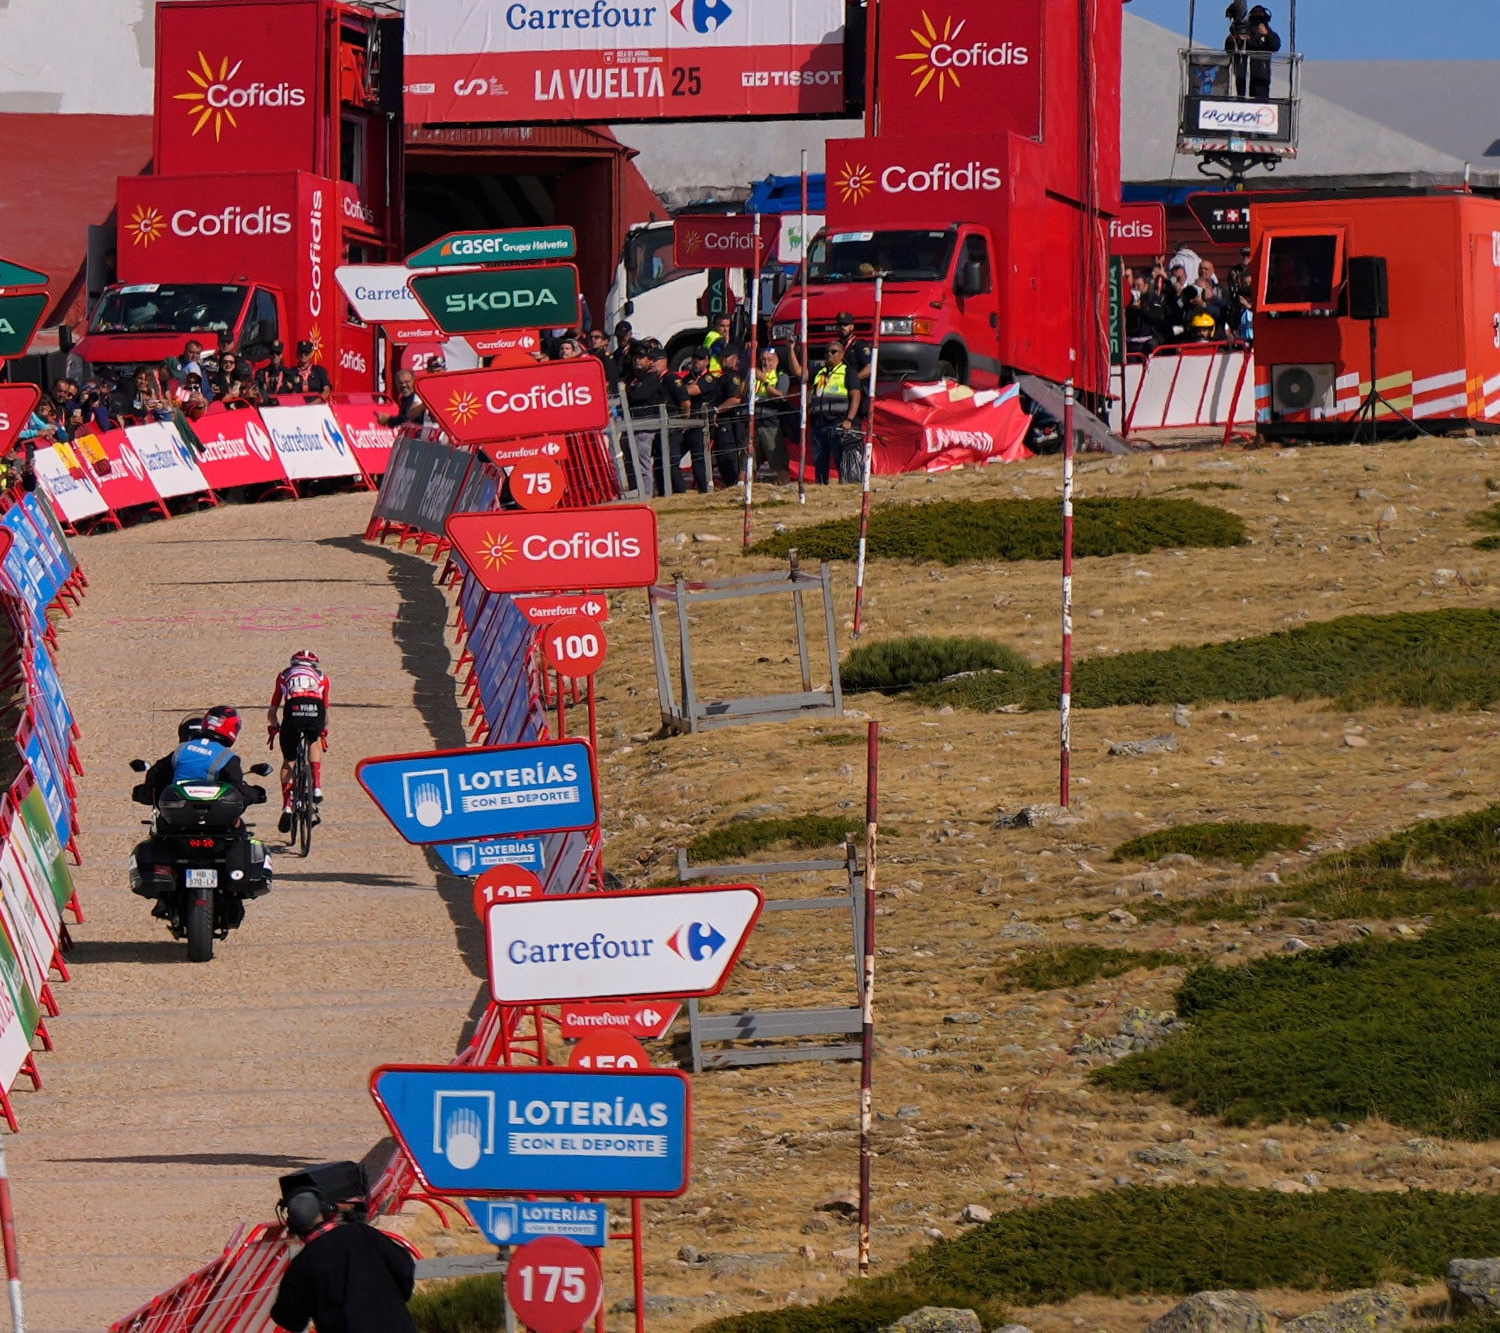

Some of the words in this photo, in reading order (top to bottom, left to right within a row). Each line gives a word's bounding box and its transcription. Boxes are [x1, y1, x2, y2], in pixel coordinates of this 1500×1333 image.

[506, 0, 656, 31] Carrefour
[929, 42, 1029, 67] Cofidis
[569, 67, 665, 100] VUELTA
[671, 66, 702, 97] 25
[771, 70, 842, 86] TISSOT
[206, 83, 306, 108] Cofidis
[881, 162, 1001, 193] Cofidis
[171, 205, 292, 236] Cofidis
[343, 196, 374, 223] Cofidis
[1110, 220, 1153, 238] fidis
[309, 189, 323, 318] Cofidis
[452, 238, 503, 255] caser
[397, 328, 433, 338] Carrefour
[476, 338, 516, 350] Carrefour
[486, 382, 593, 414] Cofidis
[272, 426, 324, 454] Carrefour
[496, 447, 539, 460] Carrefour
[522, 473, 552, 495] 75
[522, 531, 641, 561] Cofidis
[529, 605, 578, 618] Carrefour
[553, 633, 599, 662] 100
[458, 762, 578, 791] LOTERÍAS
[471, 796, 497, 808] CON
[501, 795, 515, 805] EL
[516, 790, 570, 804] DEPORTE
[479, 842, 535, 856] LOTERÍAS
[508, 933, 654, 965] Carrefour
[566, 1012, 630, 1026] Carrefour
[508, 1096, 668, 1127] LOTERÍAS
[521, 1138, 554, 1151] CON
[561, 1138, 578, 1150] EL
[582, 1138, 655, 1152] DEPORTE
[521, 1205, 598, 1222] LOTERÍAS
[519, 1266, 586, 1303] 175
